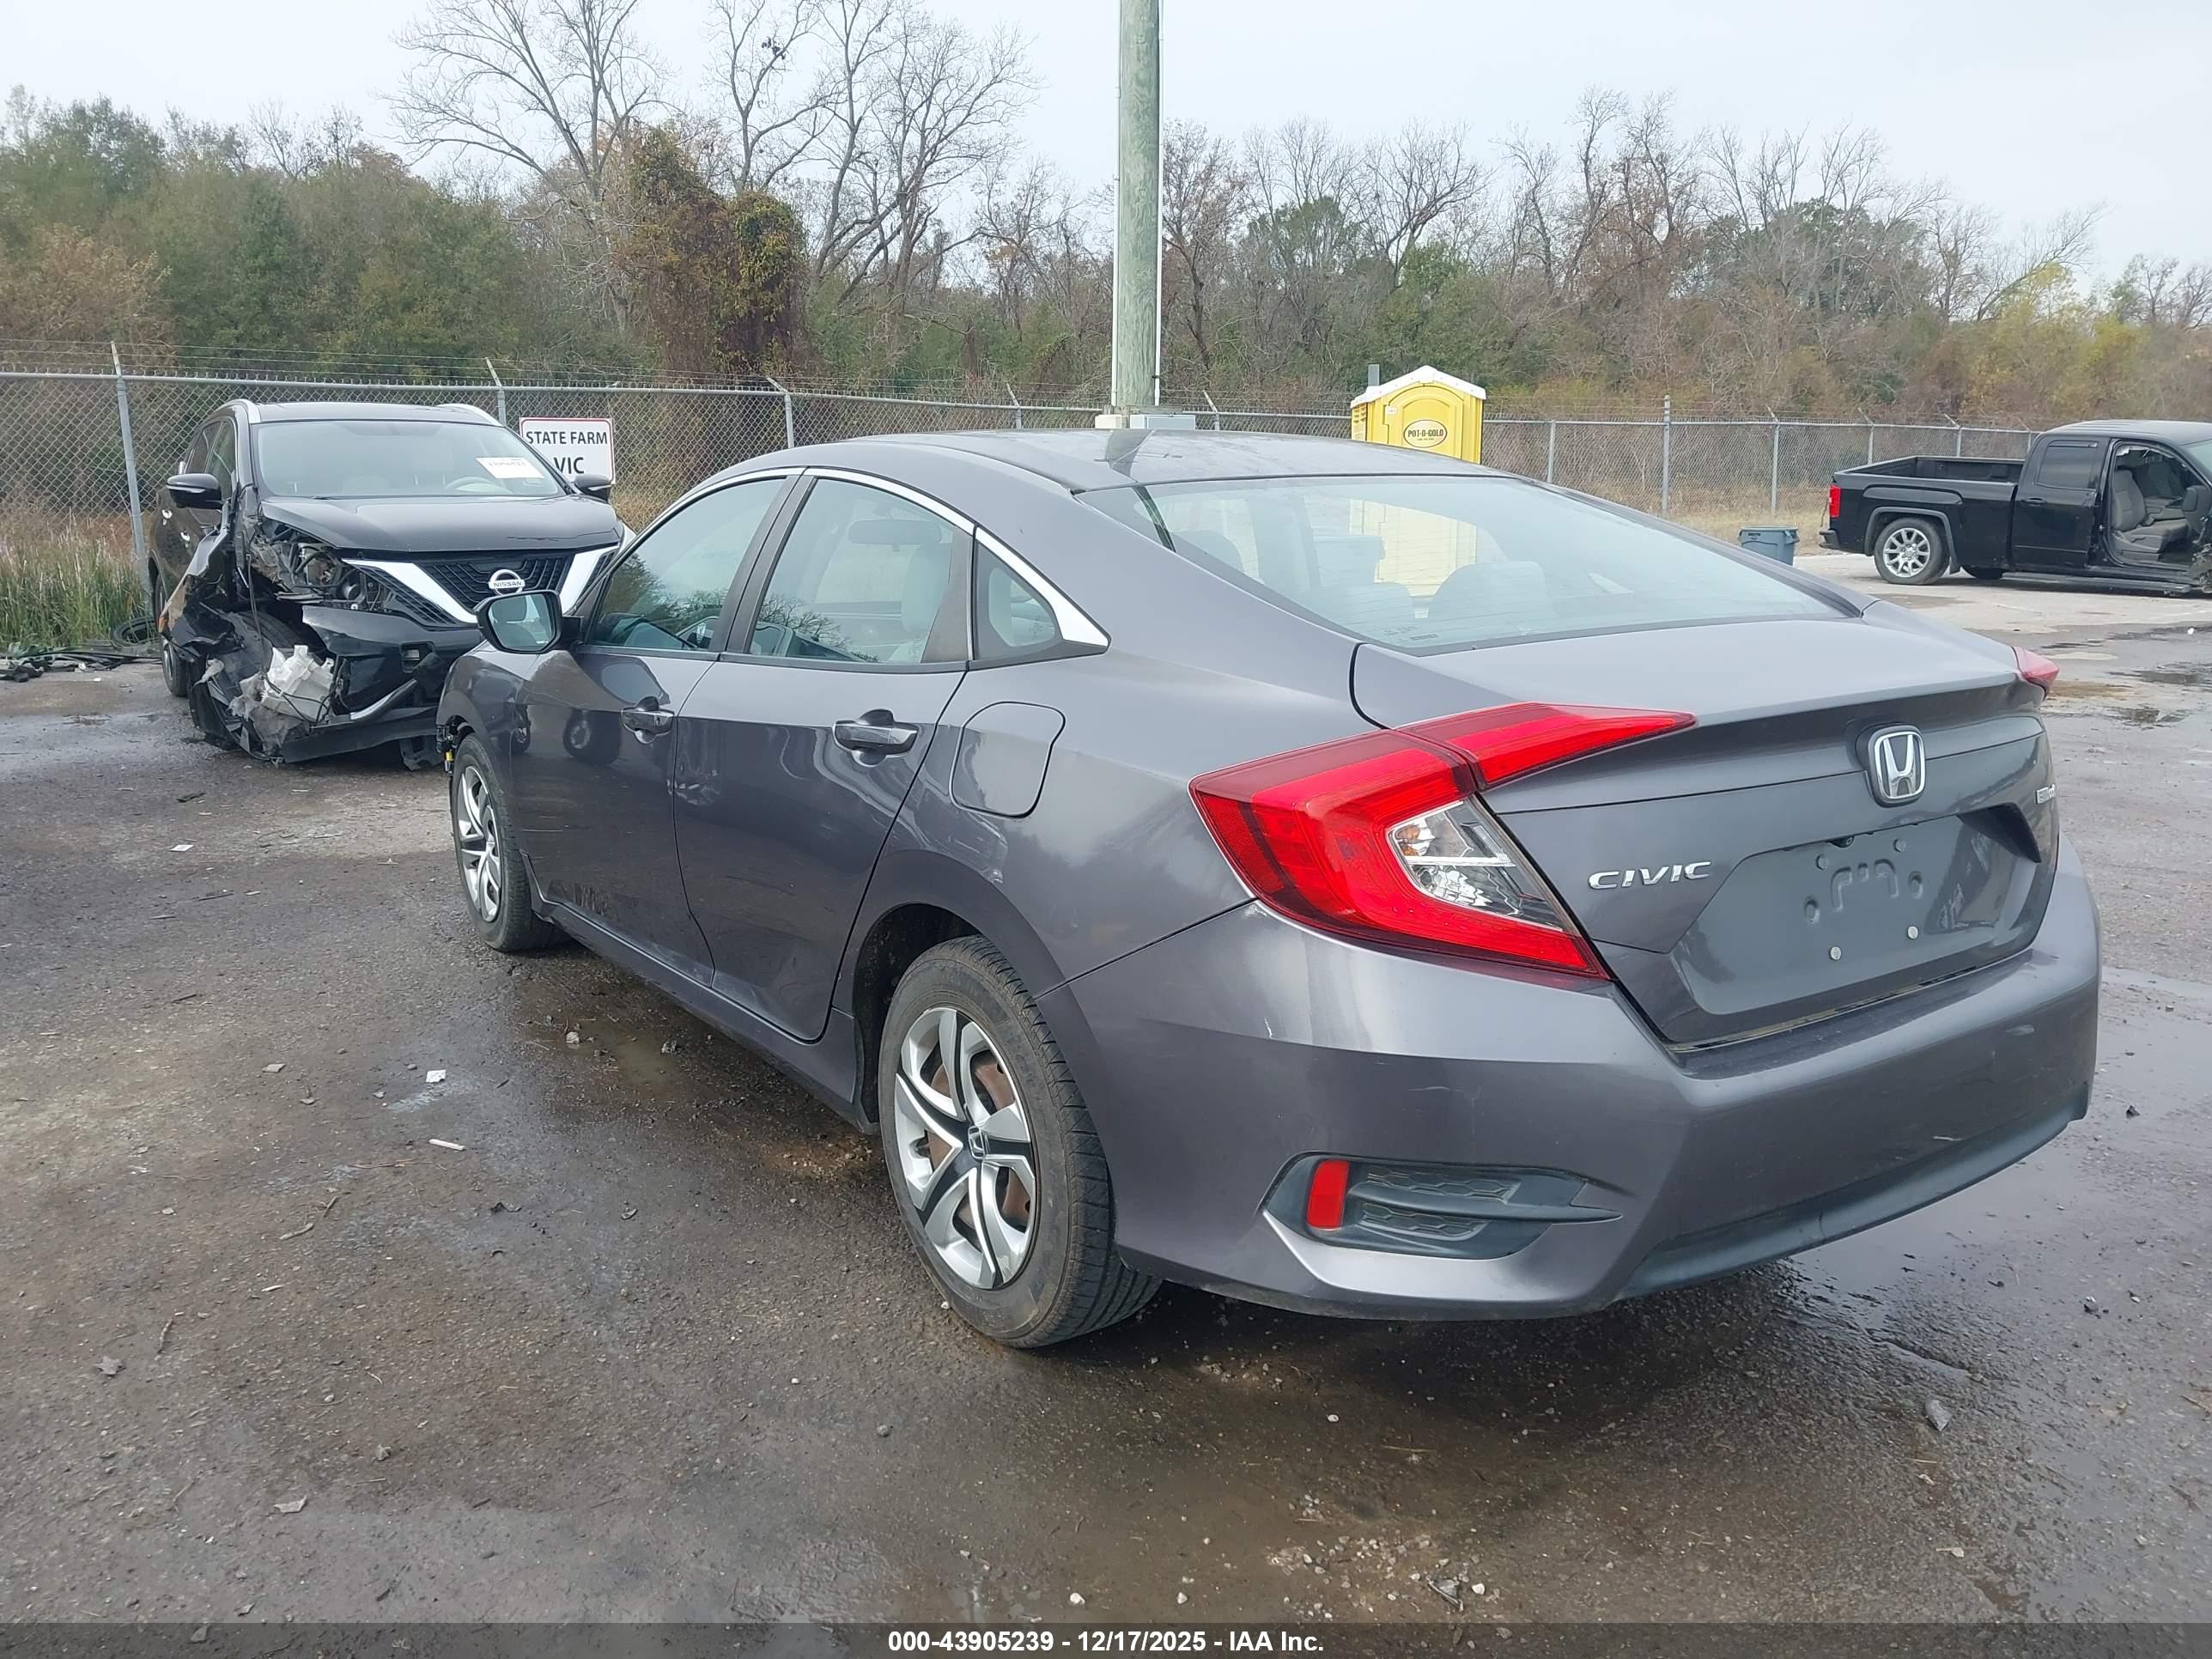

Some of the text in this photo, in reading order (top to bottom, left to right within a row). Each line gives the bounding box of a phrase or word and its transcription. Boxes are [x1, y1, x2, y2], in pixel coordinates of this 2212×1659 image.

[526, 431, 608, 445] STATE FARM
[1407, 428, 1444, 438] POT-O-GOLD
[553, 457, 585, 474] VIC
[1589, 861, 1711, 890] CIVIC
